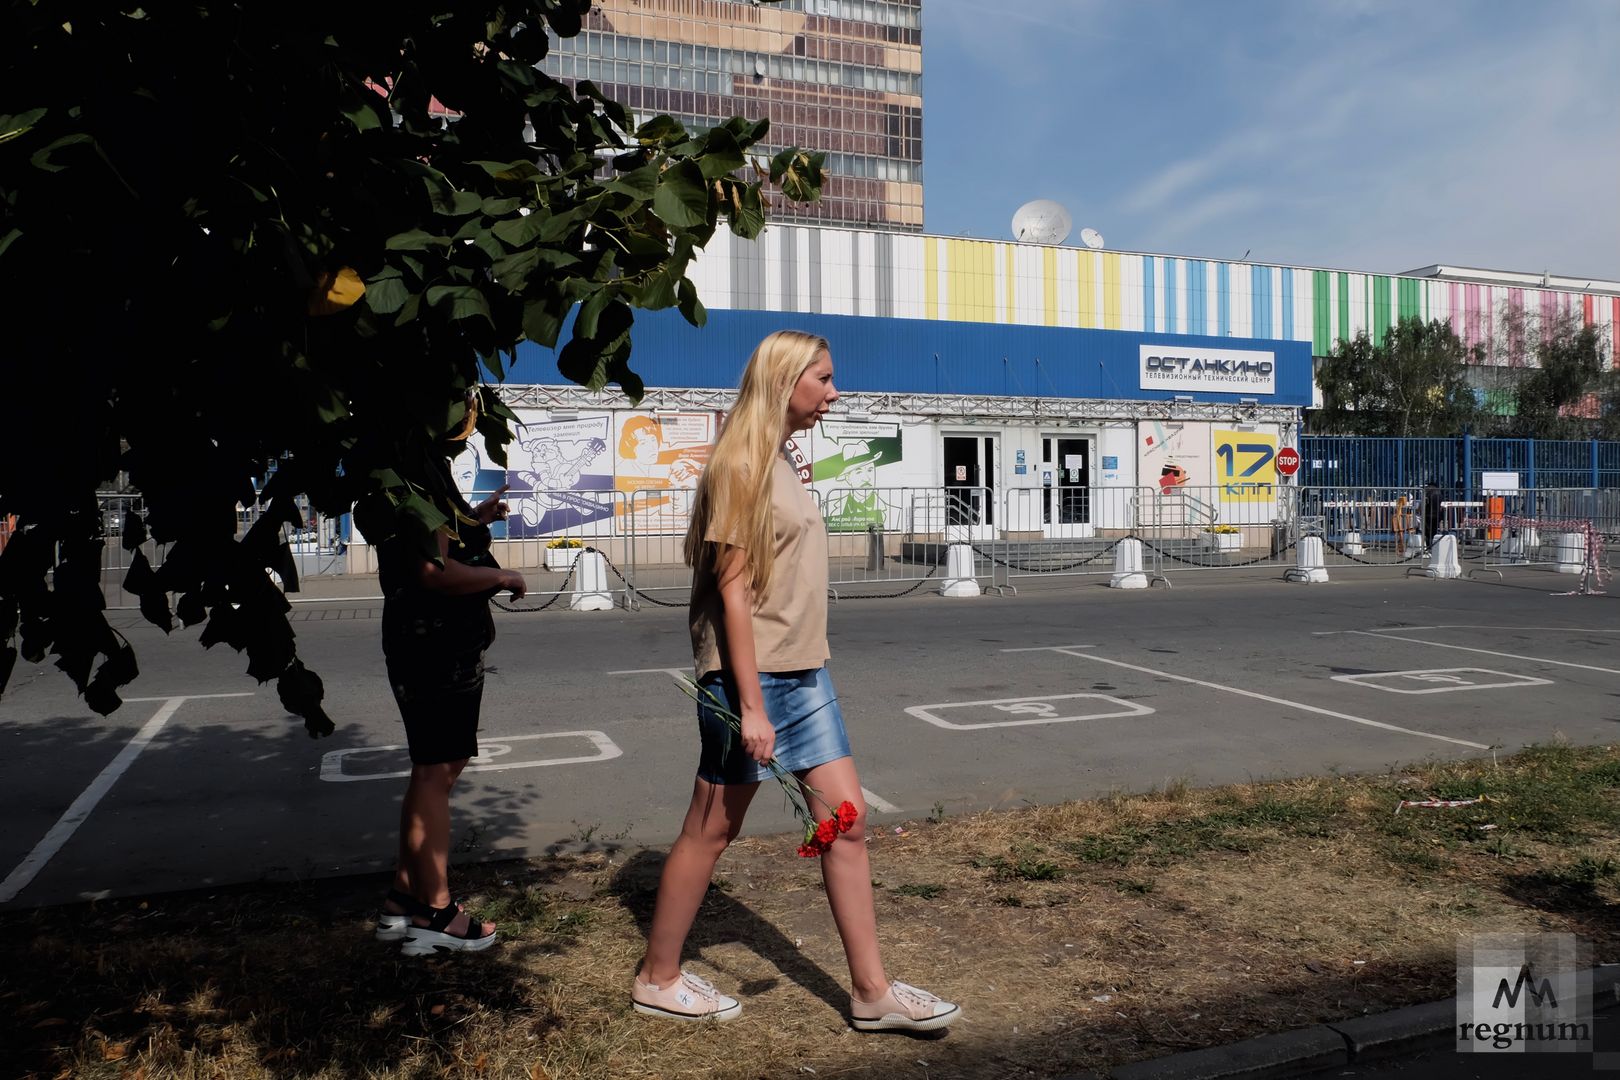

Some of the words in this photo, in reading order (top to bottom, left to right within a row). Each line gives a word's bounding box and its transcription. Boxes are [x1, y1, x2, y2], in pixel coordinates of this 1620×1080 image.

[1146, 356, 1273, 374] ОСТАНКИНО
[1145, 372, 1202, 381] ТЕЛЕВИЗИОННЫЙ
[1216, 443, 1274, 477] 17
[1279, 456, 1297, 466] STOP
[1226, 482, 1271, 495] КПП
